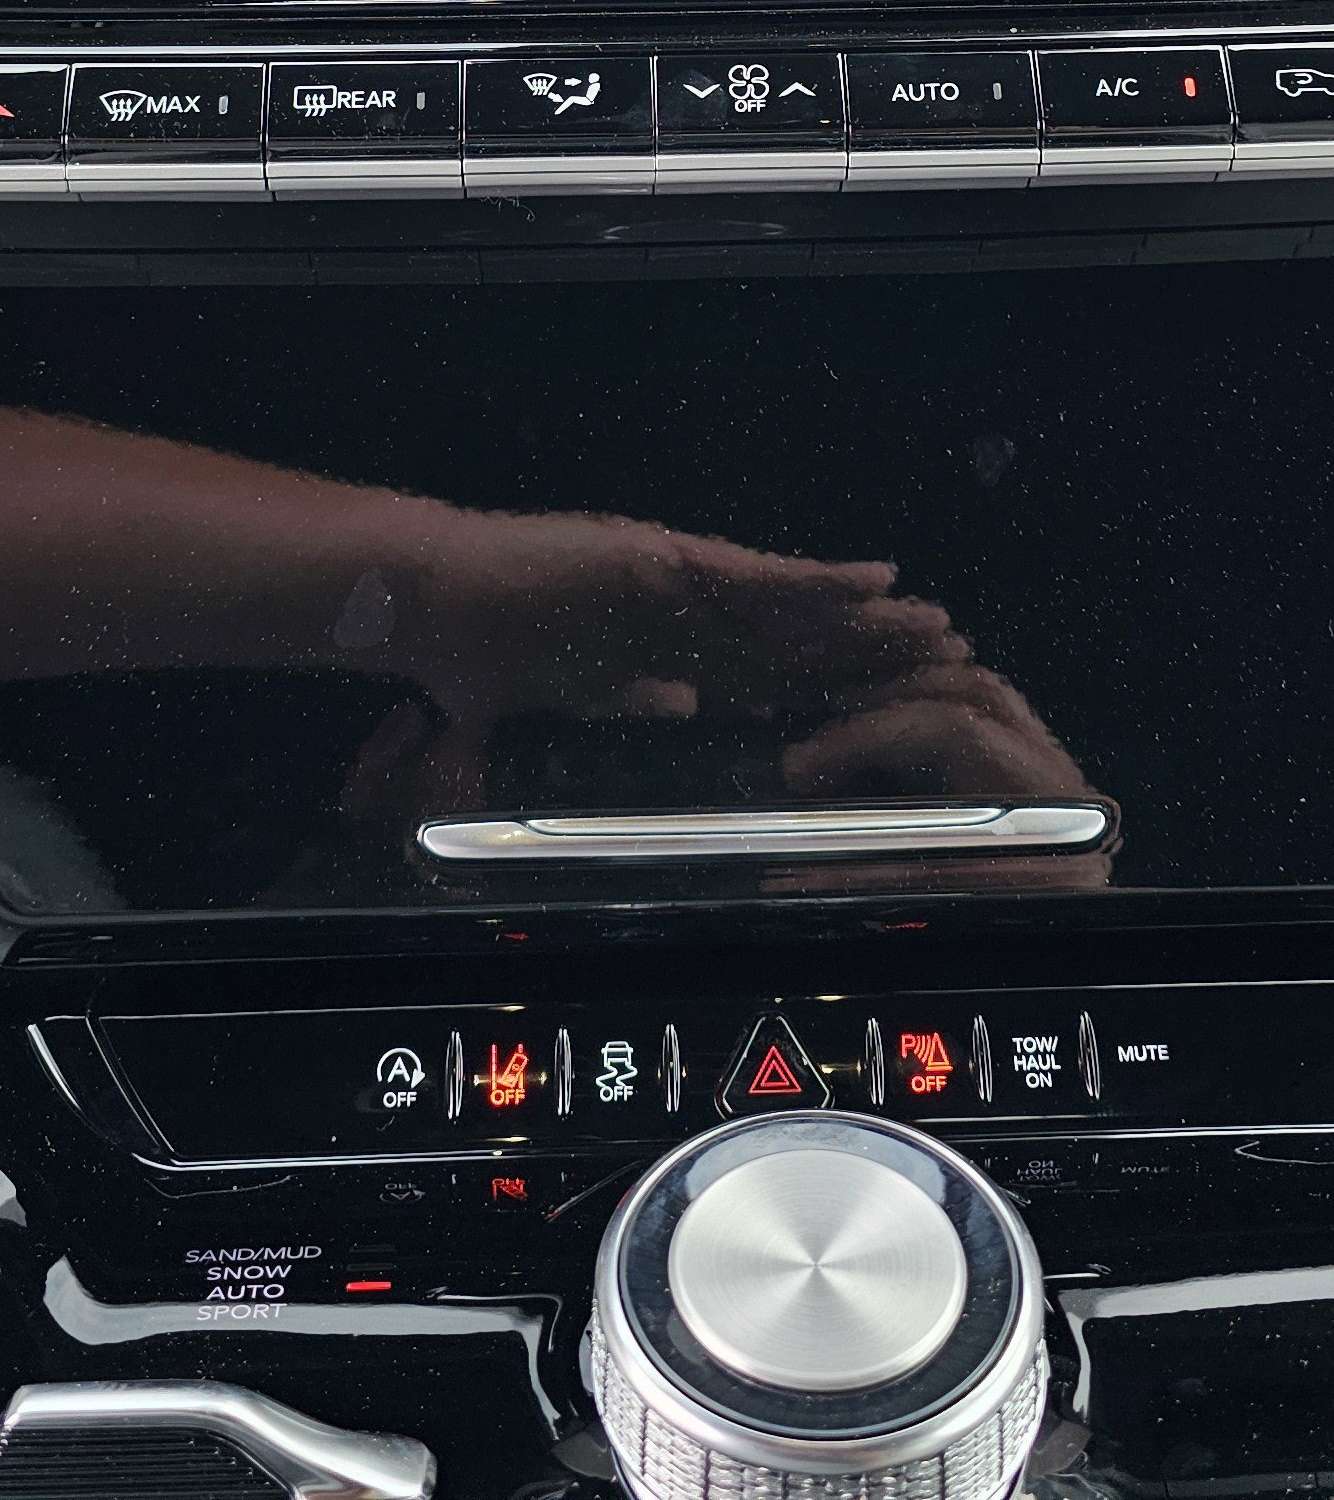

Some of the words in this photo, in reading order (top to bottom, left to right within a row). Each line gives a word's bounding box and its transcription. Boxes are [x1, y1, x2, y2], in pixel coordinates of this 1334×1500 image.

[891, 81, 960, 102] AUTO
[1095, 77, 1139, 98] A/C
[147, 95, 201, 114] MAX
[336, 90, 396, 109] REAR
[734, 99, 766, 112] OFF
[1011, 1037, 1059, 1053] TOW/
[1118, 1044, 1169, 1063] MUTE
[1012, 1055, 1061, 1071] HAUL
[911, 1076, 946, 1093] OFF
[1025, 1072, 1053, 1088] ON
[382, 1092, 417, 1108] OFF
[490, 1089, 526, 1106] OFF
[598, 1085, 634, 1102] OFF
[185, 1245, 322, 1263] SAND/MUD
[206, 1264, 292, 1281] SNOW
[206, 1284, 285, 1300] AUTO
[196, 1303, 287, 1320] SPORT
